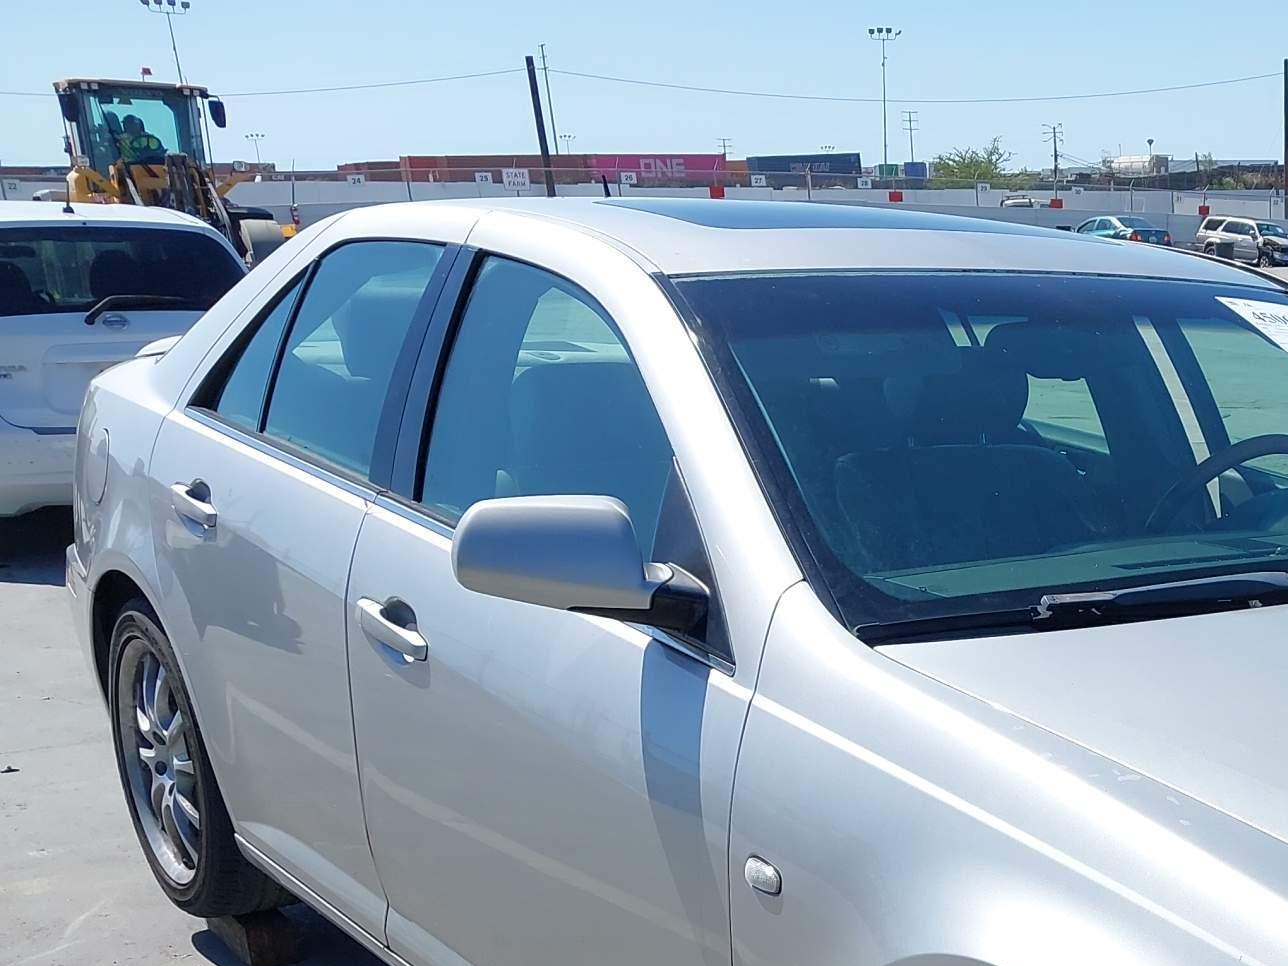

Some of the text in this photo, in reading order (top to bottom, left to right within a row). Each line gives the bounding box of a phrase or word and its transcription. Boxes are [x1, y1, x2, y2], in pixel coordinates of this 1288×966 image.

[640, 158, 685, 177] ONE
[505, 171, 525, 179] STATE
[351, 177, 361, 185] 24
[7, 182, 17, 190] 22
